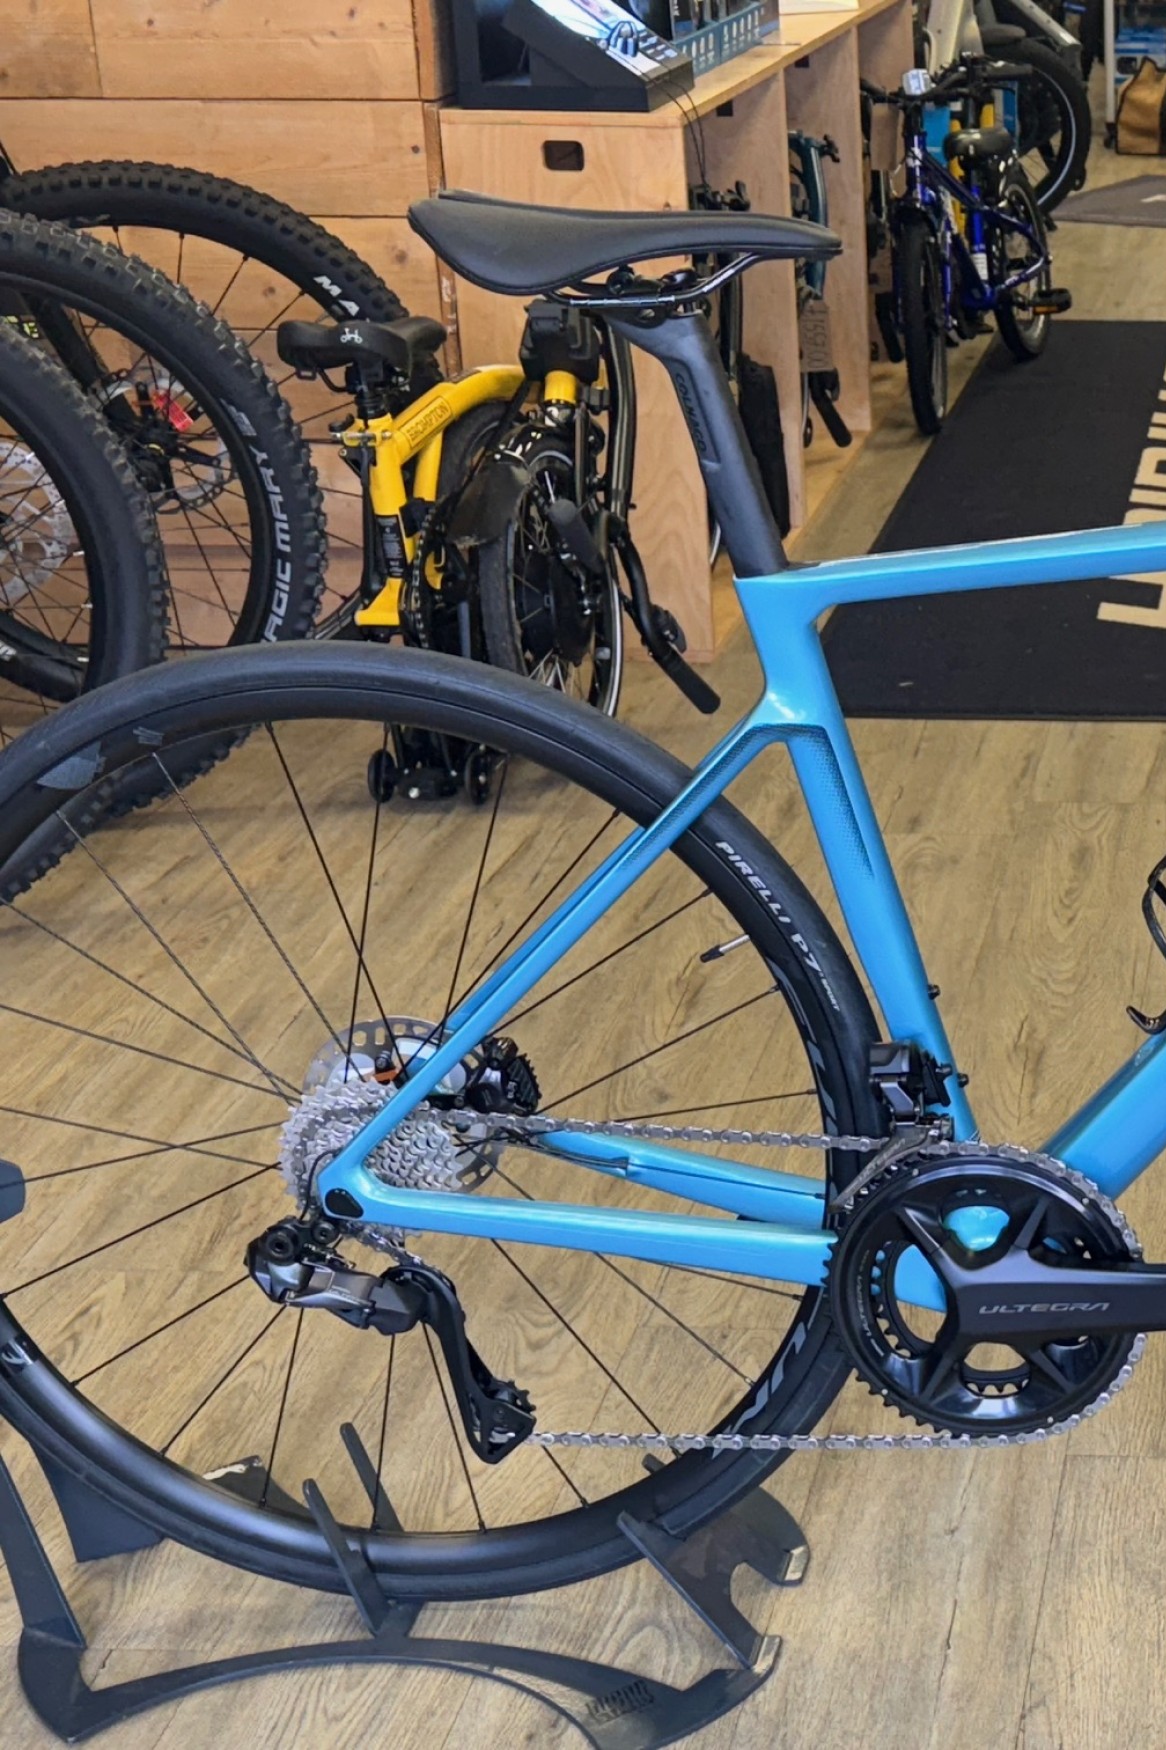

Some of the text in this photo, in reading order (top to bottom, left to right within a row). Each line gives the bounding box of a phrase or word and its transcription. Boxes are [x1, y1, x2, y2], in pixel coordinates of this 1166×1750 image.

[675, 372, 707, 453] COLNAGO
[250, 444, 291, 643] AGIC MARY
[715, 841, 791, 924] PIRELLI
[791, 933, 822, 972] P7
[979, 1302, 1111, 1315] ULTEGRA
